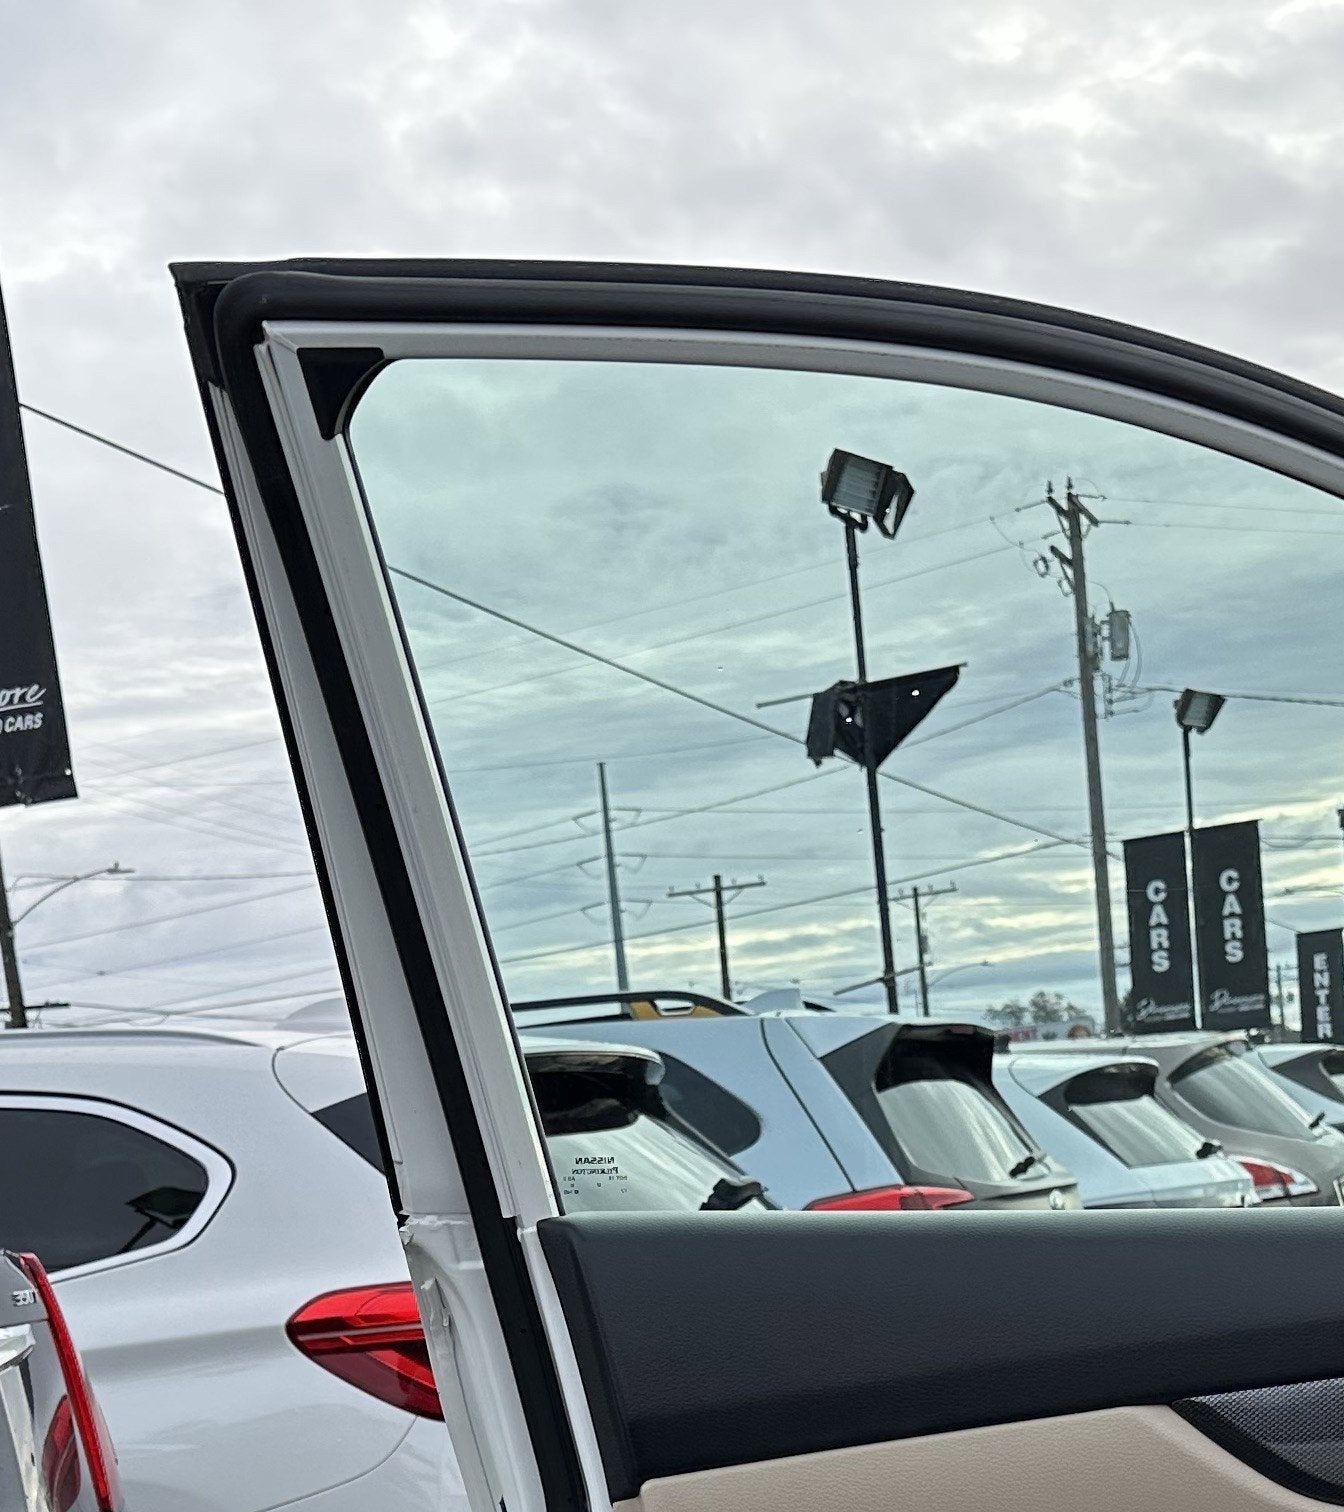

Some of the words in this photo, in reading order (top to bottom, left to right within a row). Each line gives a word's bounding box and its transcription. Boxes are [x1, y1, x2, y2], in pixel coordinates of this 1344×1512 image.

[4, 711, 44, 733] CARS
[1145, 878, 1171, 973] CARS
[1218, 867, 1245, 964] CARS
[1313, 952, 1333, 1040] ENTER
